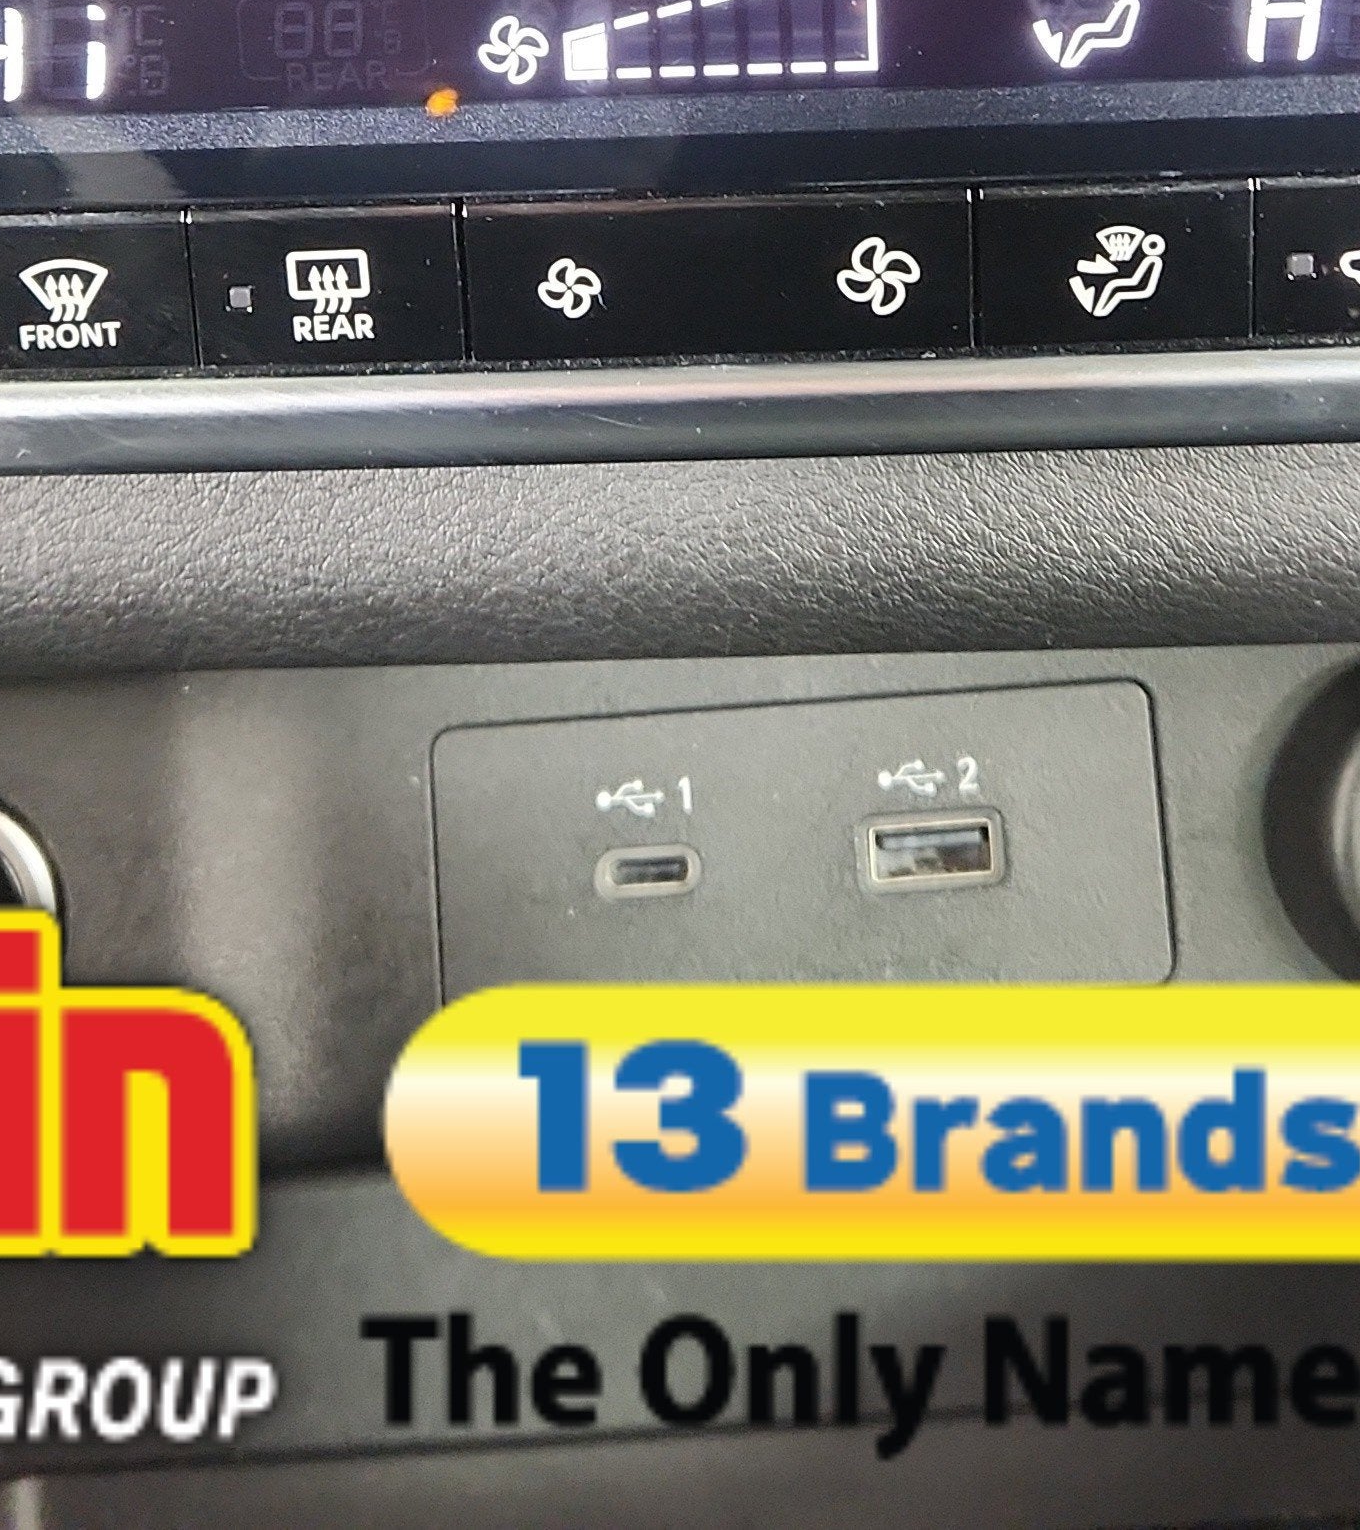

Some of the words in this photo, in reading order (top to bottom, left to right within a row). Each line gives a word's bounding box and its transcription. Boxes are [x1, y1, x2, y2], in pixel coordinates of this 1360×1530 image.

[19, 321, 121, 351] FRONT
[292, 314, 375, 342] REAR
[957, 756, 981, 794] 2
[677, 776, 694, 815] 1
